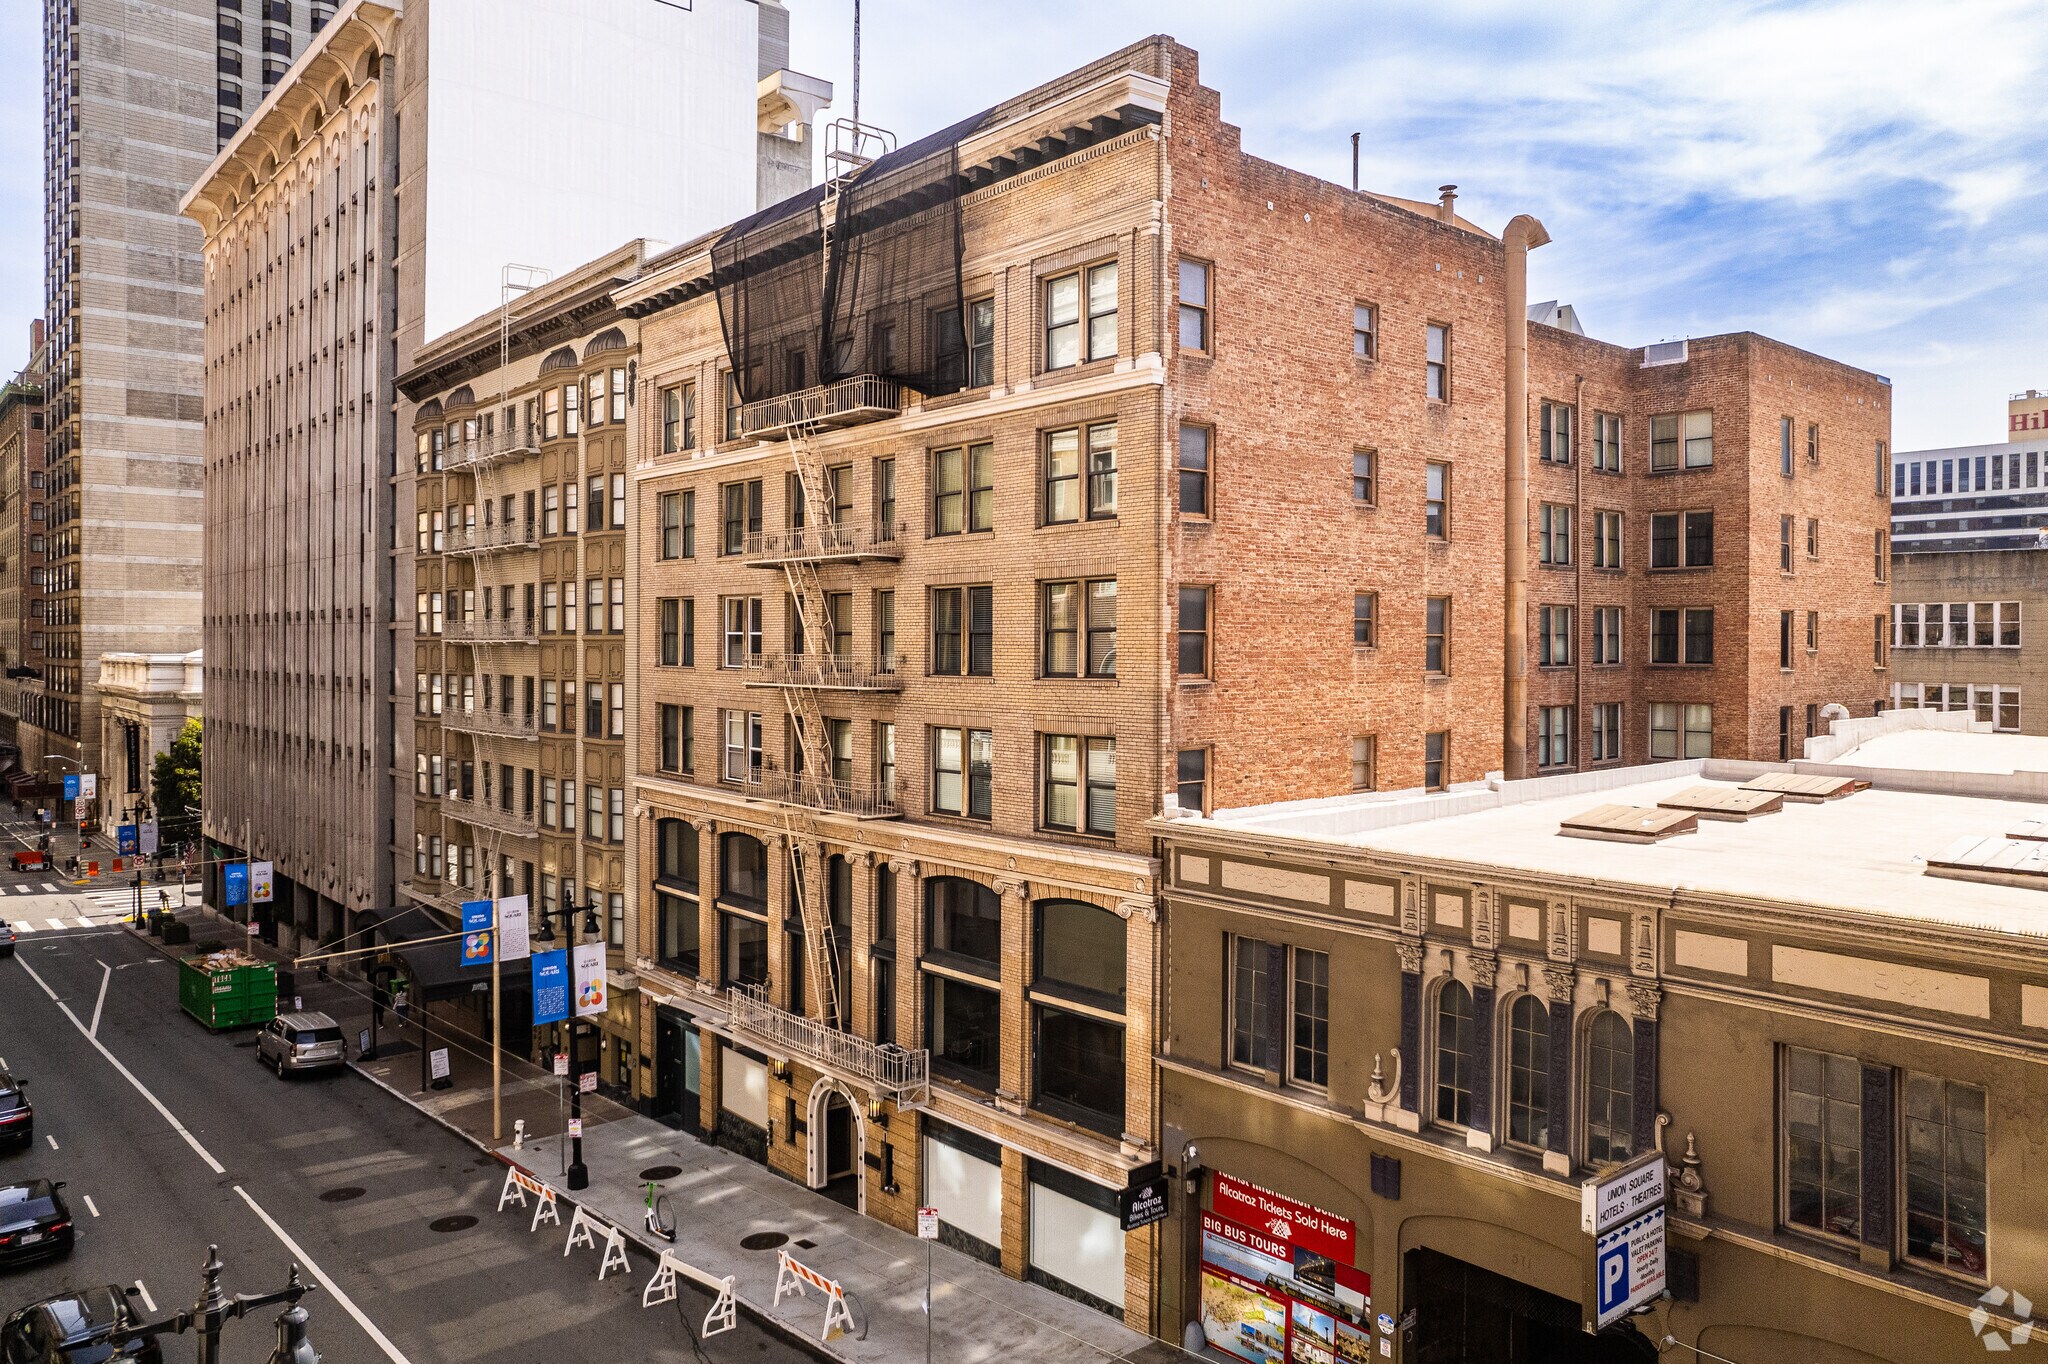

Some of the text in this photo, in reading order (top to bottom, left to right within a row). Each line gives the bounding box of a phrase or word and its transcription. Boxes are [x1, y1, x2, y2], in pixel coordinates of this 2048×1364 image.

[1608, 1170, 1654, 1202] UNION SQUARE
[1129, 1205, 1163, 1222] Bikes & Tours
[1132, 1196, 1162, 1213] Alcatraz
[1220, 1182, 1256, 1206] Alcatraz
[1258, 1196, 1292, 1220] Tickets
[1295, 1211, 1318, 1230] Sold
[1321, 1220, 1347, 1240] Here
[1600, 1183, 1662, 1223] HOTELS THEATRES
[1204, 1217, 1221, 1232] BIG
[1225, 1224, 1246, 1242] BUS
[1249, 1234, 1286, 1258] TOURS
[1630, 1234, 1645, 1247] PUBLIC
[1650, 1225, 1663, 1236] HOTEL
[1631, 1236, 1663, 1258] VALET PARKING
[1637, 1247, 1658, 1264] OPEN 24/7
[1605, 1254, 1624, 1304] P
